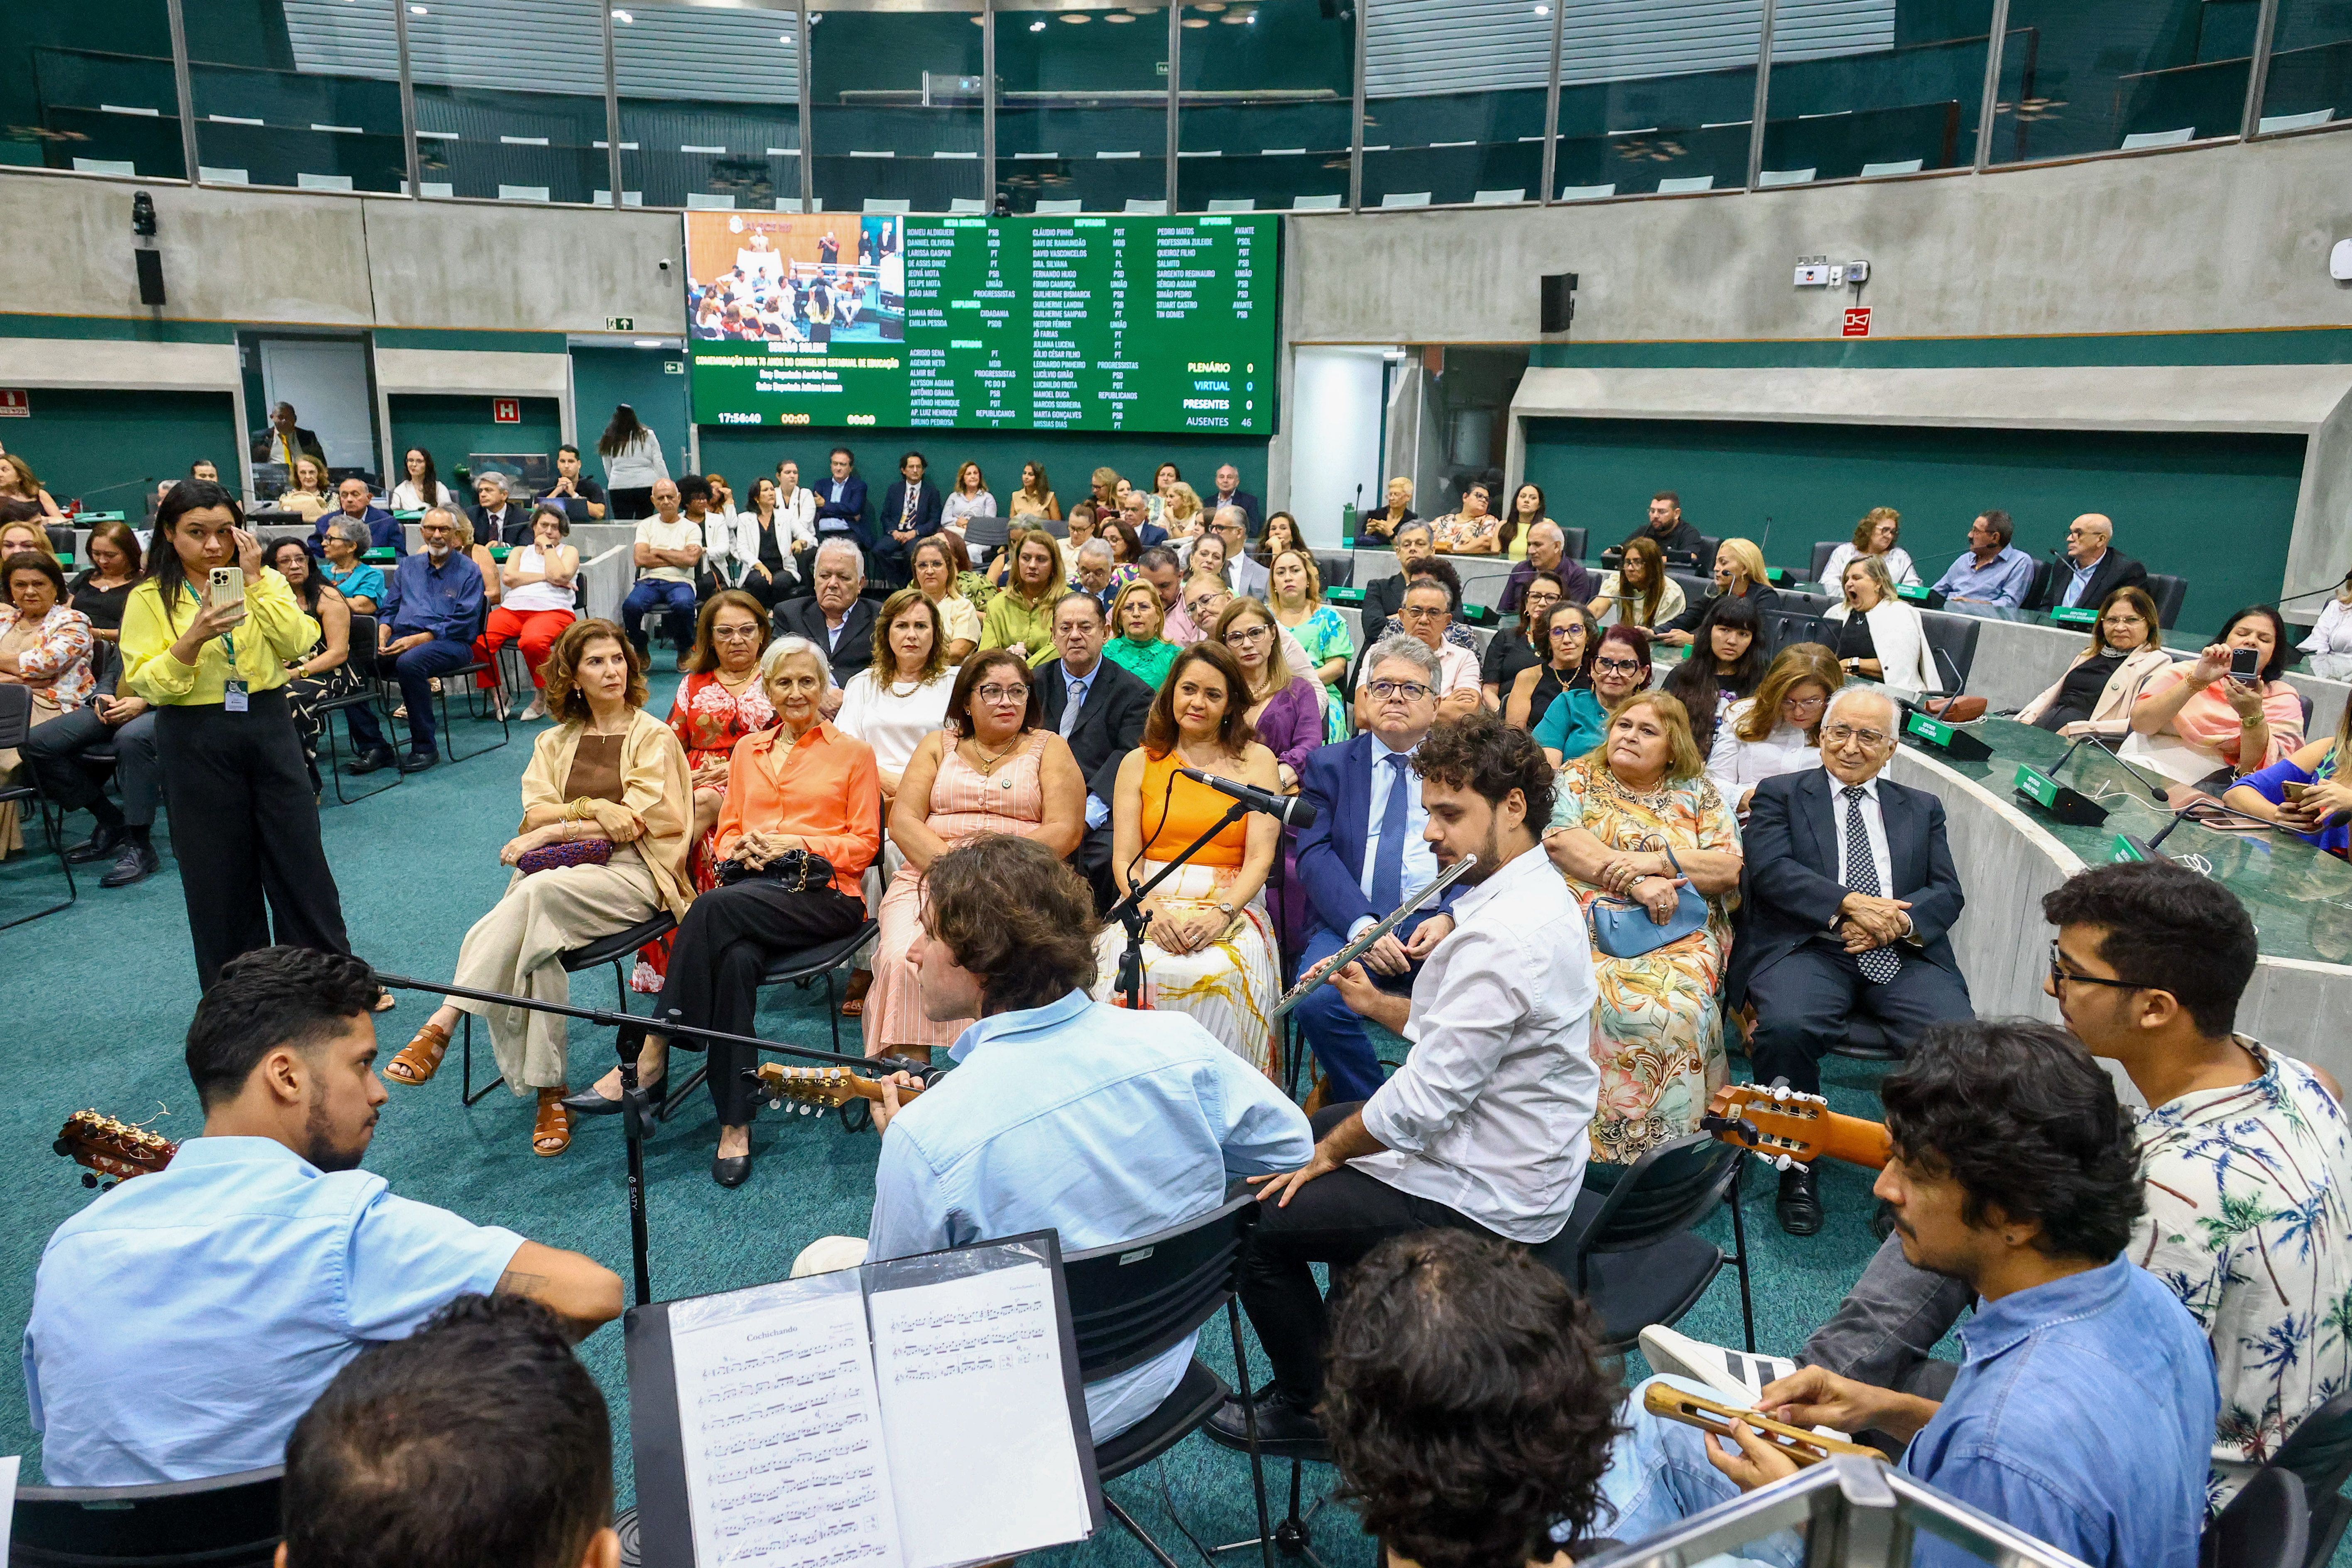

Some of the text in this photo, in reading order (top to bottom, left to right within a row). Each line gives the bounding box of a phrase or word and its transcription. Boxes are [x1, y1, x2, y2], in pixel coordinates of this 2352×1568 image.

[1033, 228, 1056, 236] CLÁUDIO
[1235, 269, 1252, 277] UNIÃO
[986, 279, 1002, 287] UNIÃO
[1050, 281, 1076, 289] CAMURÇA
[1157, 279, 1175, 287] SÉRGIO
[1156, 289, 1174, 298] SIMÃO
[1053, 319, 1071, 328] FÉRRER
[1110, 320, 1127, 328] UNIÃO
[1033, 349, 1047, 357] JÚLIO
[1049, 349, 1064, 358] CÉSAR
[1188, 361, 1253, 373] PLENÁRIO 0
[1057, 370, 1073, 378] GIRÃO
[1194, 381, 1253, 391] VIRTUAL 0
[911, 387, 933, 396] ANTÔNIO
[911, 397, 933, 406] ANTÔNIO
[1183, 399, 1252, 410] PRESENTES 0
[500, 404, 514, 418] H
[1052, 411, 1082, 419] GONÇALVES
[718, 412, 761, 423] 17:56:40
[781, 413, 810, 424] 00:00
[847, 414, 875, 425] 00:00
[1186, 417, 1252, 427] AUSENTES 46
[747, 1325, 798, 1342] Cochichando
